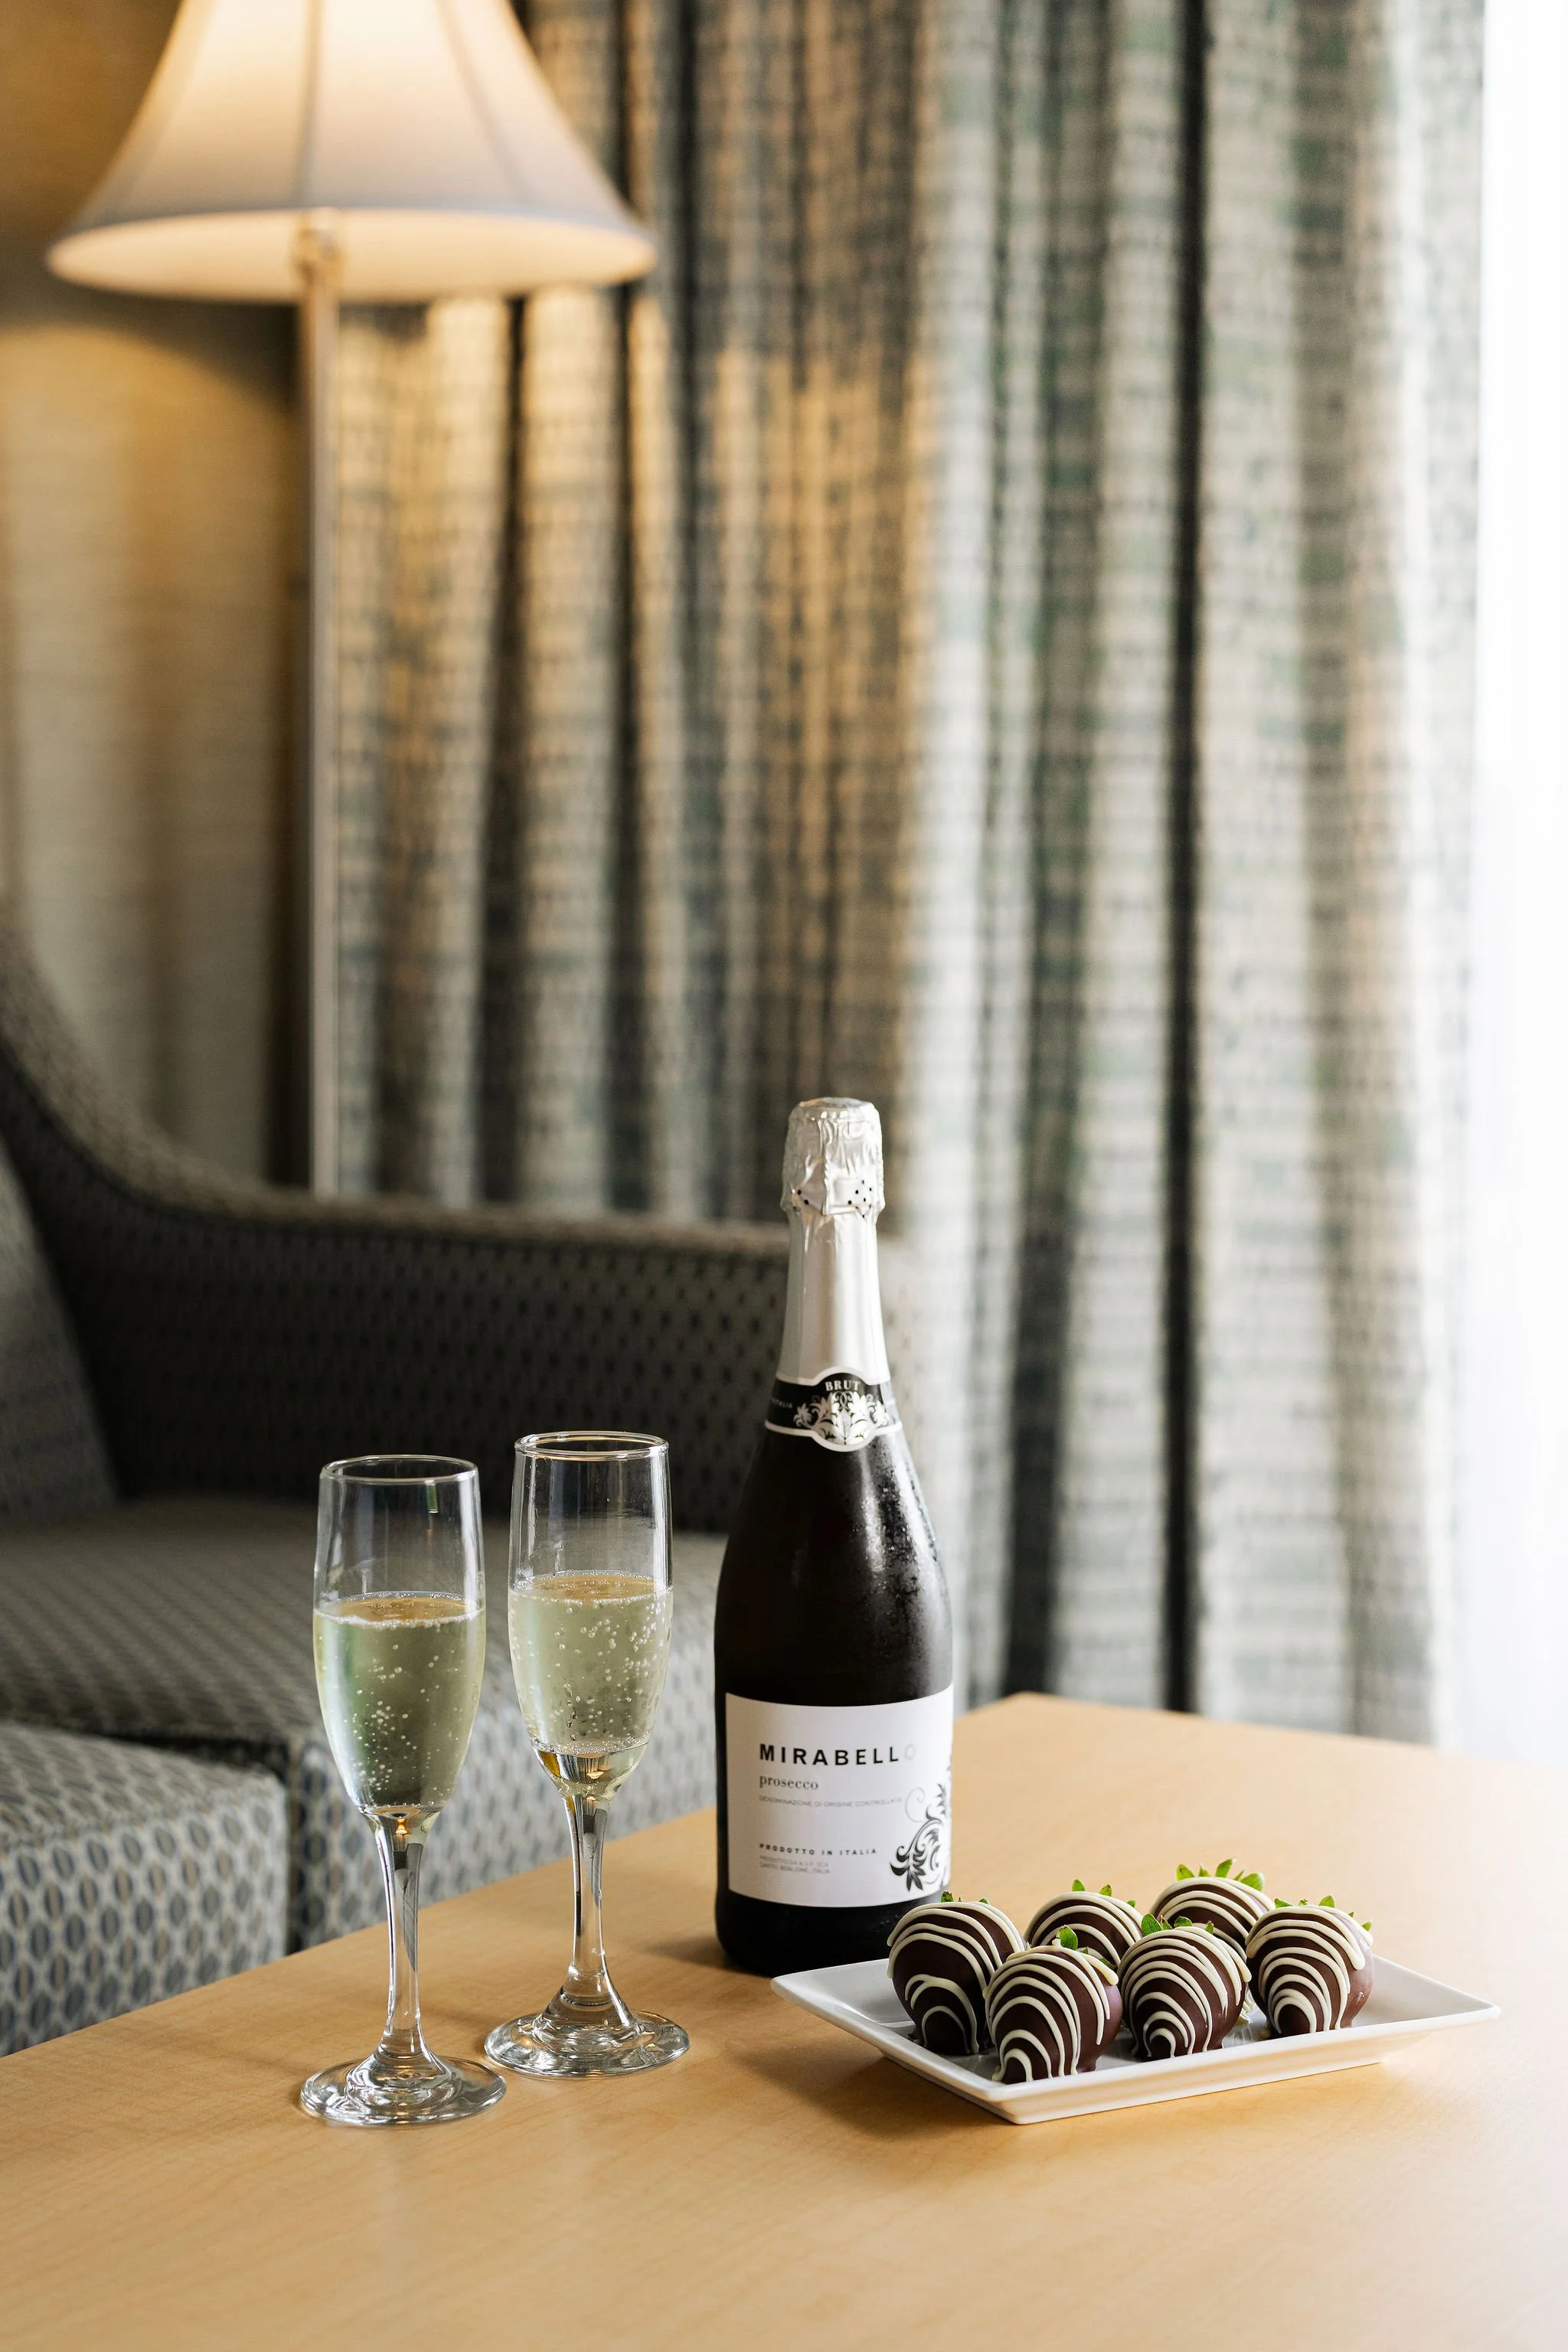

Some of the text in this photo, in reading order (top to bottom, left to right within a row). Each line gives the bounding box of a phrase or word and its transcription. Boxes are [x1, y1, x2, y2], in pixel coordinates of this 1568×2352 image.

[825, 1380, 861, 1392] BRUT
[760, 1743, 916, 1766] MIRABELLO
[759, 1775, 819, 1791] prosecco
[760, 1843, 815, 1856] PRODOTTO
